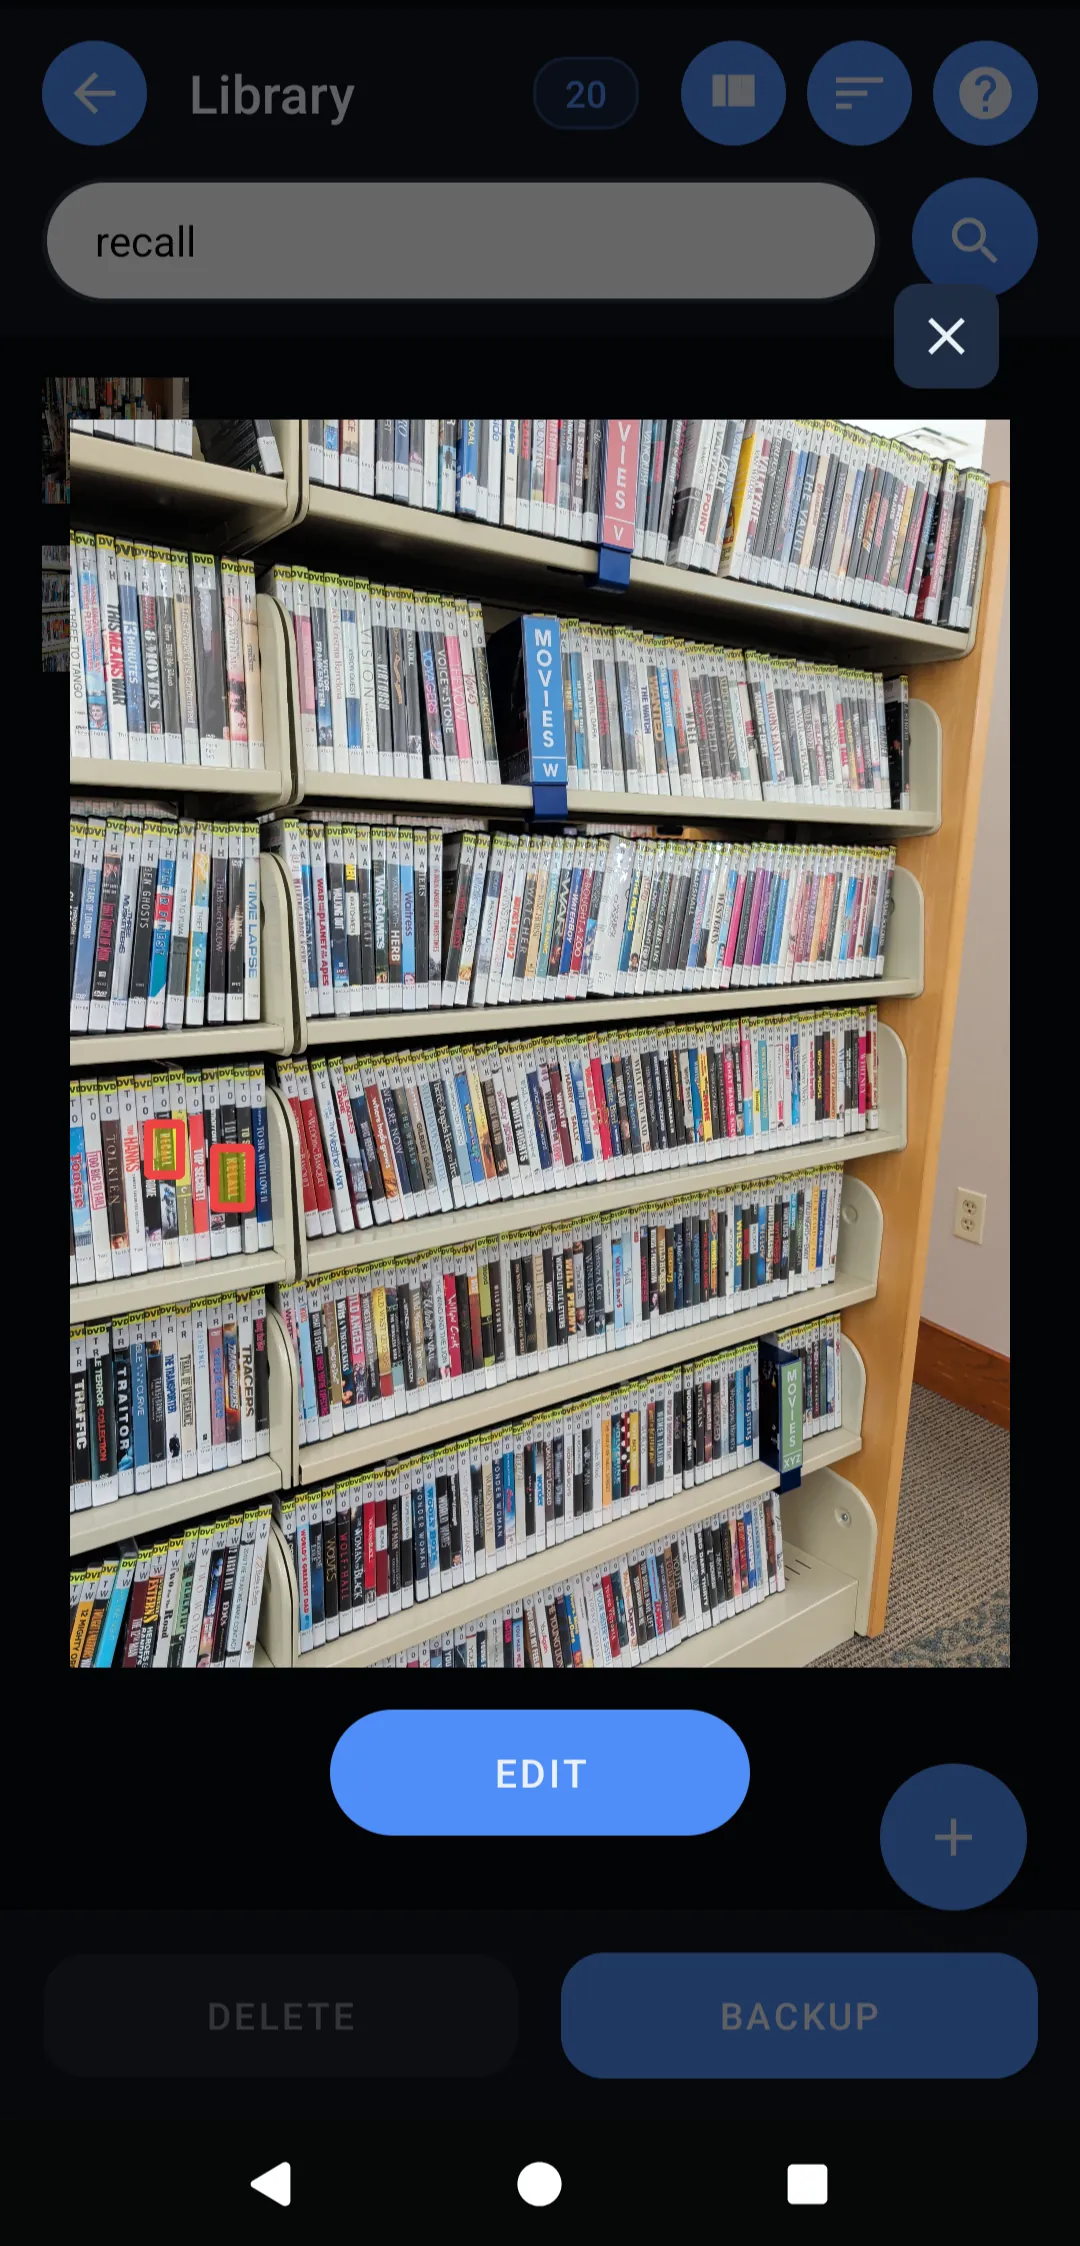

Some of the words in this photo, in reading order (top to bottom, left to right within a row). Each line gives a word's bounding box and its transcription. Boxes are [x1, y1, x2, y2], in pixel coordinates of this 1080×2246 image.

[192, 73, 355, 125] Library
[567, 81, 605, 108] 20
[98, 224, 193, 257] recall
[615, 421, 631, 509] VIES
[640, 430, 652, 487] VANQUISH
[706, 431, 723, 492] VANTAGE
[716, 455, 729, 493] VAULT
[699, 493, 711, 534] POINT
[613, 525, 624, 541] V
[107, 604, 121, 631] THIS
[123, 620, 137, 636] 13
[71, 646, 80, 660] TO
[144, 631, 155, 641] 8
[109, 632, 124, 678] MEANS
[127, 637, 138, 684] MINUTES
[360, 628, 374, 698] VISION
[73, 663, 83, 698] TANGO
[112, 678, 126, 705] WAR
[145, 643, 160, 709] MOVIES
[423, 650, 437, 714] VOYAGERS
[438, 650, 447, 684] VOICE
[443, 696, 454, 733] STONE
[454, 688, 466, 721] VOW
[534, 629, 552, 748] MOVIES
[543, 763, 558, 777] W
[643, 705, 651, 734] WATCH
[648, 676, 664, 742] WANTED
[248, 882, 257, 920] TIME
[316, 878, 324, 900] WAR
[405, 892, 413, 936] Waitress
[519, 886, 535, 953] WATCHER
[248, 923, 258, 979] LAPSE
[390, 930, 400, 962] HERB
[574, 935, 583, 957] ZOO
[256, 1126, 266, 1137] TO
[89, 1153, 100, 1168] TOO
[106, 1134, 120, 1206] TOLKIEN
[124, 1136, 140, 1173] HANKS
[194, 1147, 204, 1165] TOP
[258, 1155, 267, 1175] WITH
[90, 1169, 101, 1180] BIG
[92, 1181, 103, 1190] TO
[226, 1157, 239, 1200] RECALL
[258, 1176, 268, 1195] LOVE
[335, 1170, 344, 1190] Man
[565, 1259, 575, 1289] WILL
[566, 1292, 576, 1333] PENNY
[94, 1368, 104, 1407] TERROR
[243, 1344, 254, 1417] TRACERS
[74, 1379, 87, 1450] TRAFFIC
[117, 1366, 132, 1451] TRAITOR
[136, 1385, 145, 1416] CURVE
[787, 1368, 798, 1447] MOVIES
[783, 1453, 801, 1469] XYZ
[673, 1555, 681, 1589] YOUTH
[81, 1609, 89, 1617] 12
[188, 1600, 203, 1654] WOMEN
[73, 1619, 87, 1651] MIGHTY
[497, 1759, 586, 1788] EDIT
[210, 2003, 353, 2030] DELETE
[723, 2003, 877, 2030] BACKUP
